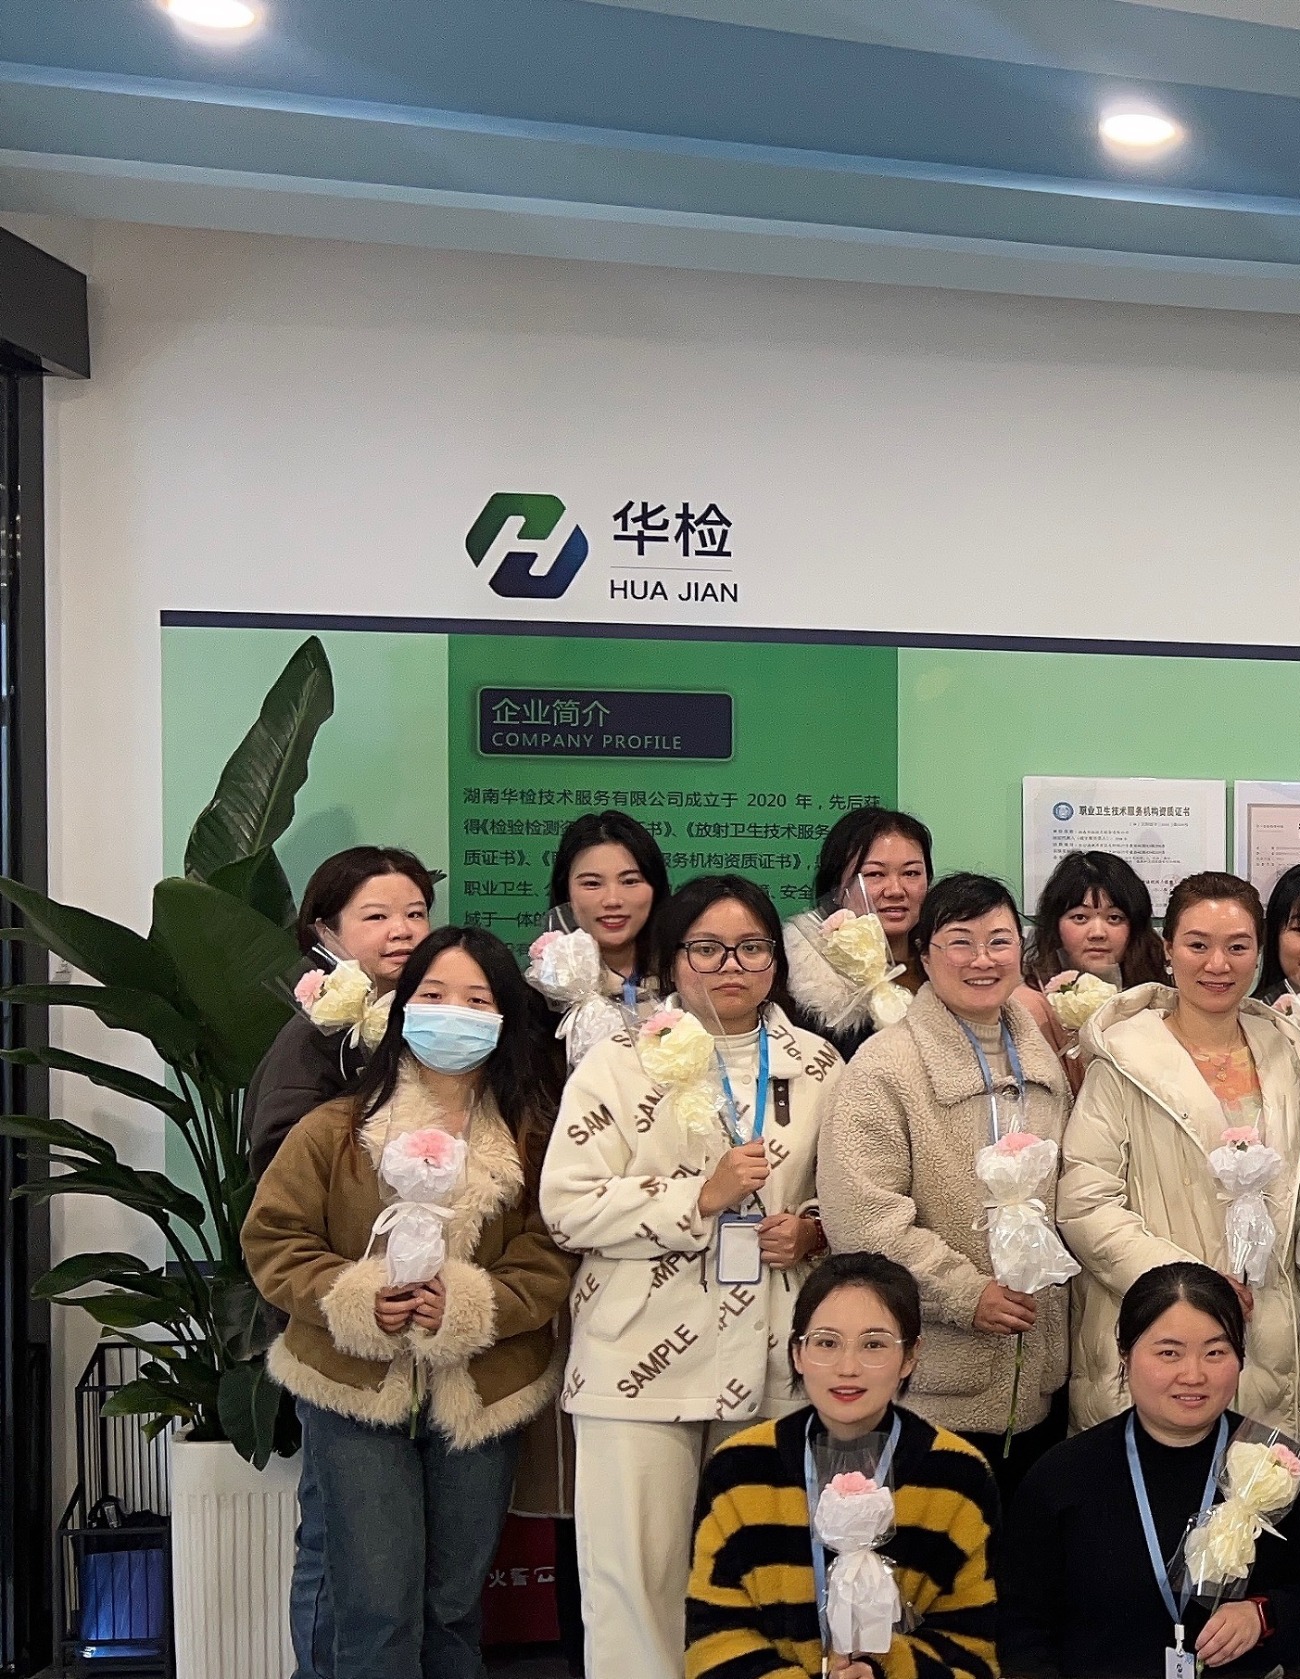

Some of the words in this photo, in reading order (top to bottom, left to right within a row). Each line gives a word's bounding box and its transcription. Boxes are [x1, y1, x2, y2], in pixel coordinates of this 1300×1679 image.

[613, 500, 733, 558] 华检
[609, 580, 668, 601] HUA
[678, 582, 738, 602] JIAN
[492, 698, 610, 728] 企业简介
[492, 732, 594, 749] COMPANY
[602, 735, 682, 751] PROFILE
[463, 787, 739, 809] 湖南华检技术服务有限公司成立于
[746, 793, 787, 808] 2020
[1079, 805, 1190, 817] 职业卫生技术服务机构资质证书
[567, 1103, 615, 1146] SAM
[617, 1323, 699, 1399] SAMPLE
